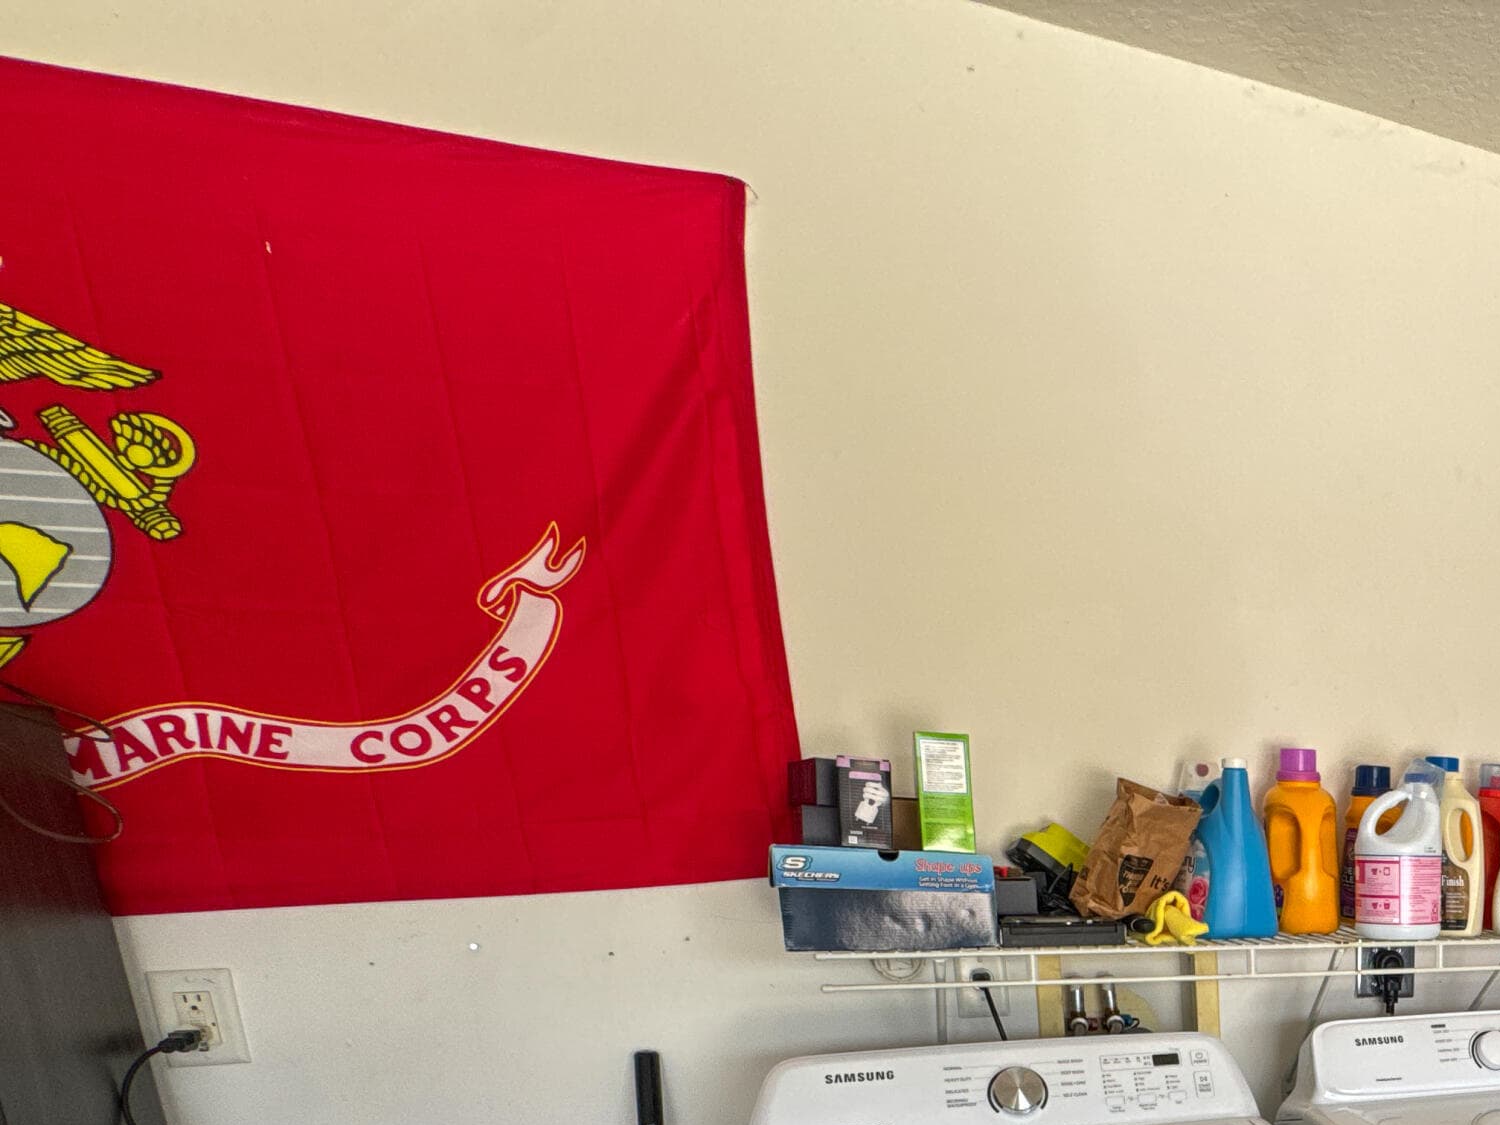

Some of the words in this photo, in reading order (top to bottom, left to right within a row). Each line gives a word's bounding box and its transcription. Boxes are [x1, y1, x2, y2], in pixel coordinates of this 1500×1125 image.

[64, 712, 294, 781] MARINE
[350, 646, 528, 764] CORPS
[915, 858, 954, 876] Shape
[959, 863, 982, 876] ups
[783, 871, 840, 879] SKECHERS
[1441, 875, 1464, 887] Finish
[1150, 875, 1170, 892] It's
[1354, 1035, 1405, 1047] SAMSUNG
[825, 1070, 895, 1085] SAMSUNG
